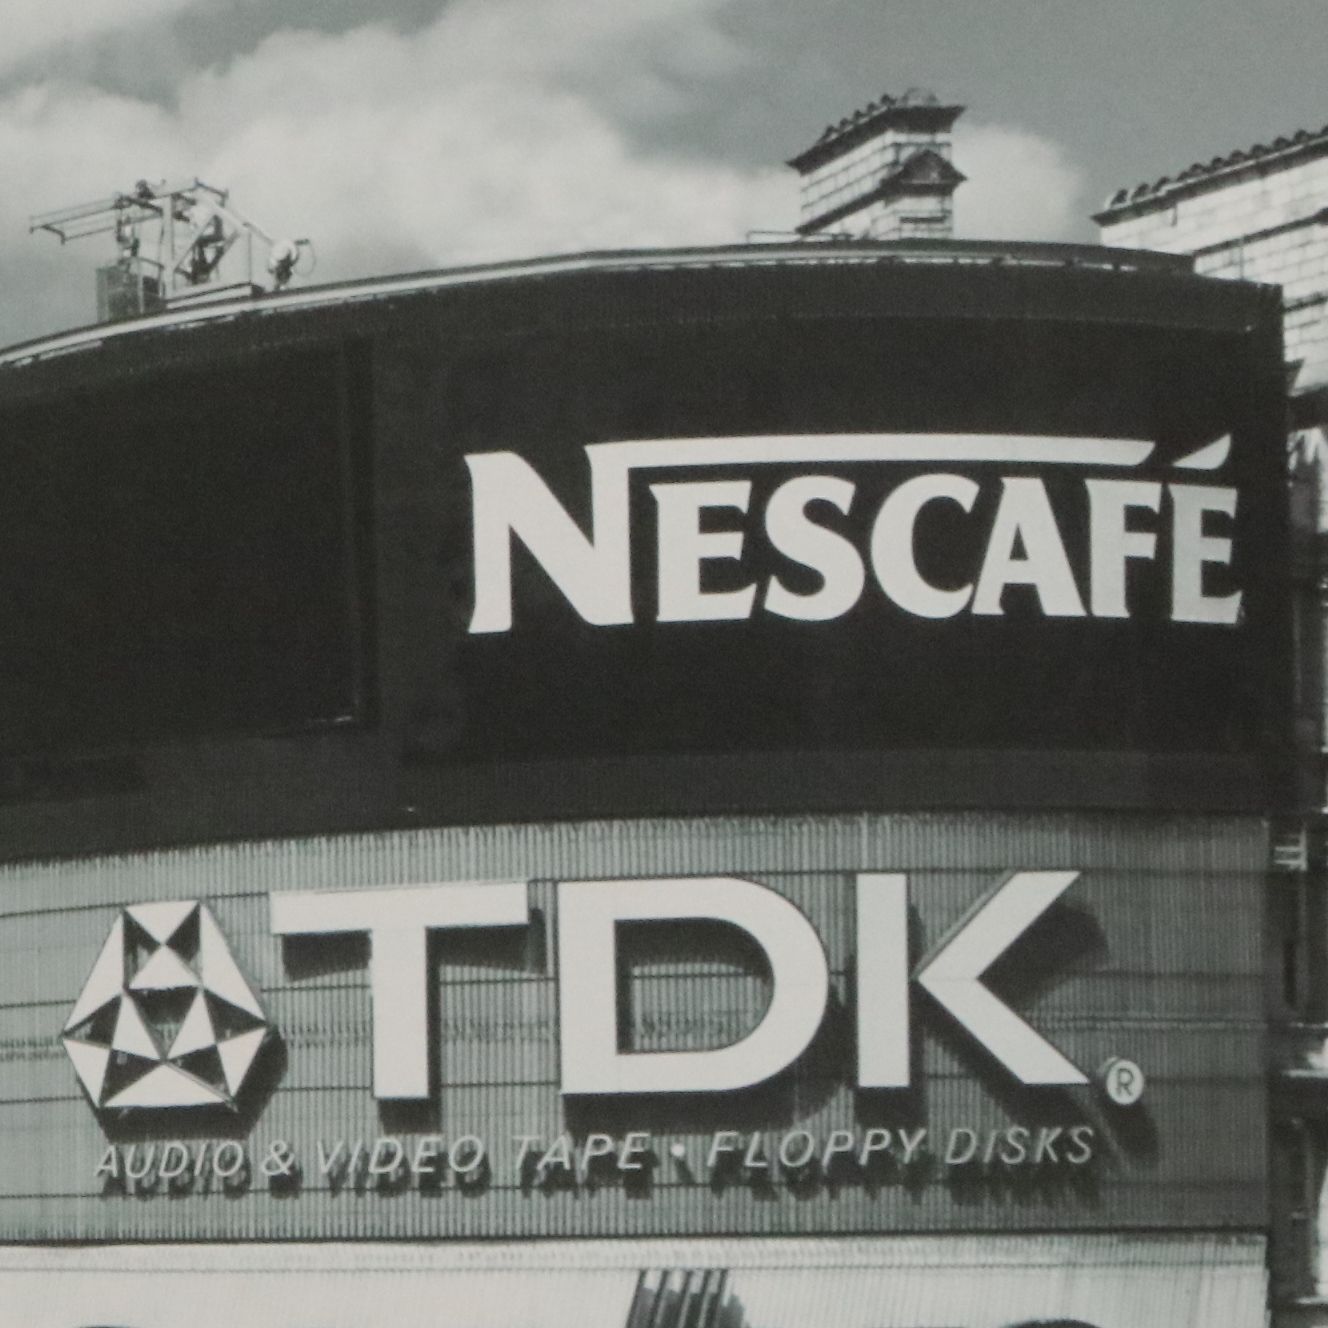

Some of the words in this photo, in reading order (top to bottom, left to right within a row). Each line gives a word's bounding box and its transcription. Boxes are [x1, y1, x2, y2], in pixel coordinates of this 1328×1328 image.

[464, 432, 1243, 633] NESCAFÉ
[271, 870, 1091, 1101] TDK
[93, 1140, 245, 1179] AUDIO
[259, 1138, 297, 1177] &
[315, 1134, 485, 1175] VIDEO
[510, 1132, 651, 1171] TAPE
[706, 1128, 929, 1168] FLOPPY
[944, 1126, 1096, 1165] DISKS
